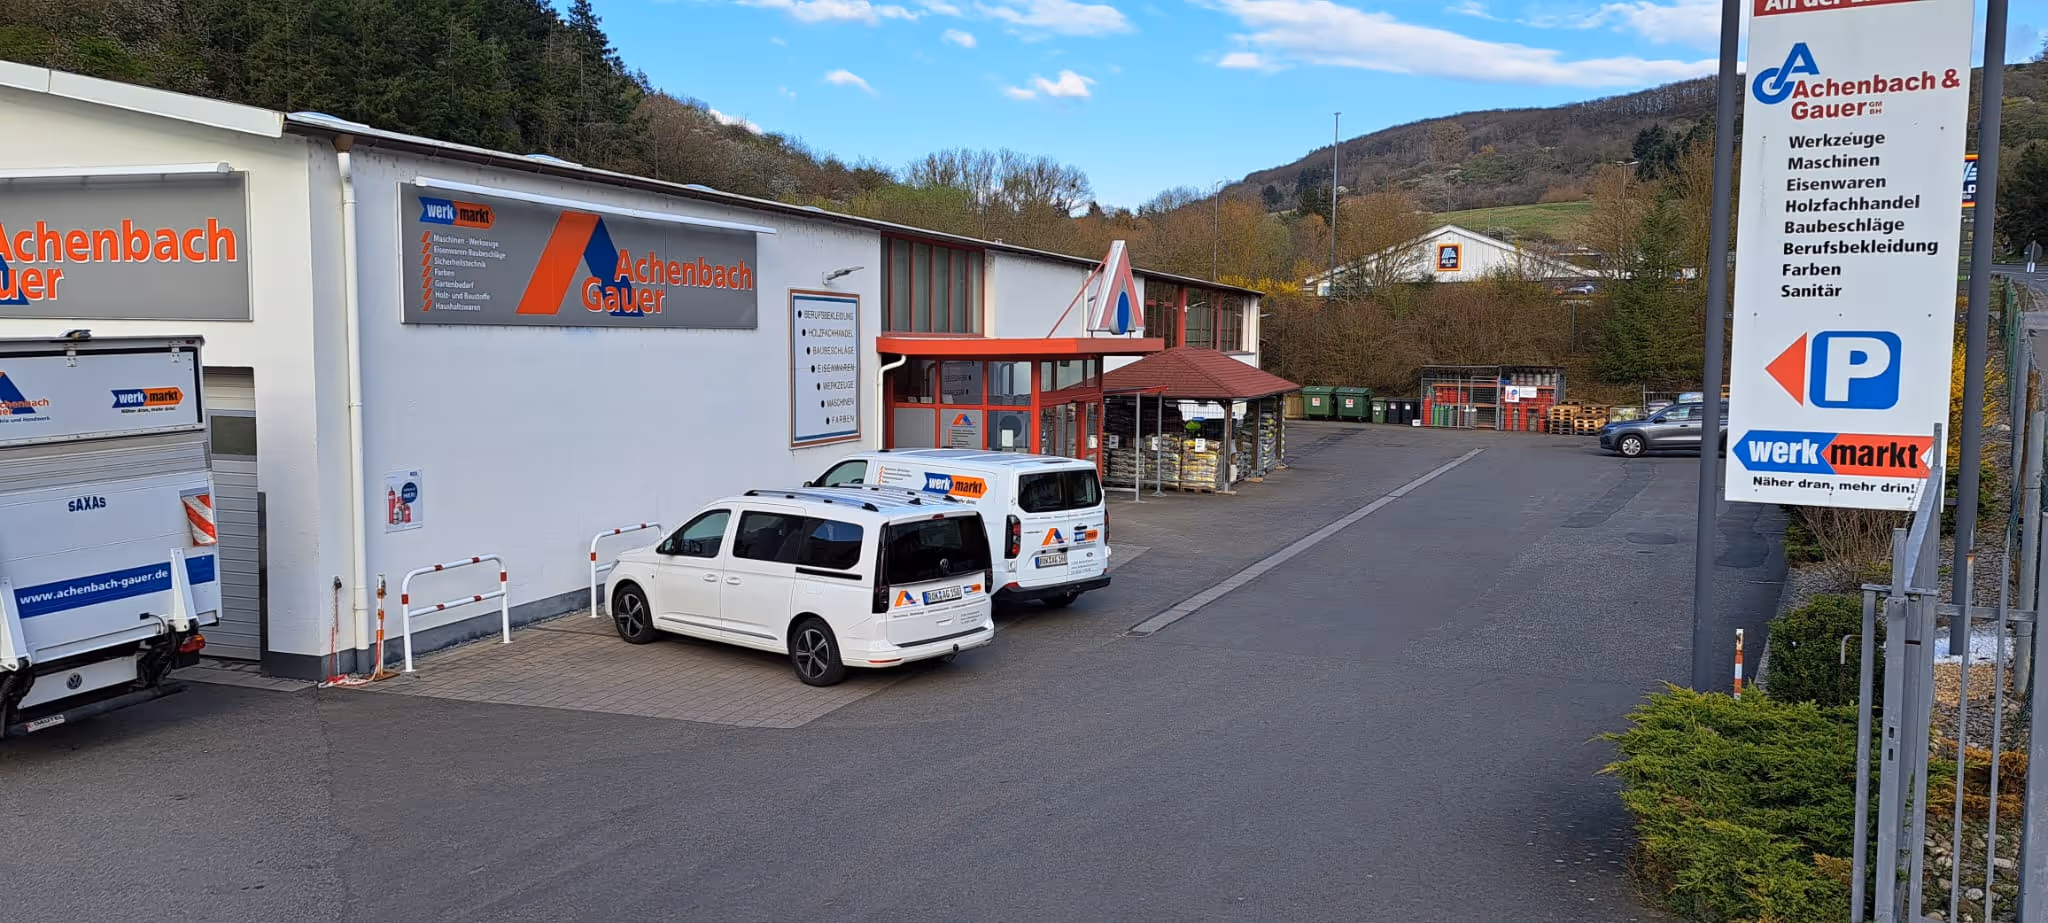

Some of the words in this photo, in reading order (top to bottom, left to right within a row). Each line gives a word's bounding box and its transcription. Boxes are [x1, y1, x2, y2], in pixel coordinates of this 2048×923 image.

[1791, 71, 1936, 99] Achenbach
[1941, 68, 1961, 89] &
[1791, 101, 1868, 121] Gauer
[1789, 132, 1886, 149] Werkzeuge
[1787, 153, 1880, 170] Maschinen
[1786, 176, 1887, 192] Eisenwaren
[1785, 194, 1920, 213] Holzfachhandel
[426, 204, 454, 220] werk
[459, 208, 489, 224] markt
[1784, 218, 1905, 234] Baubeschläge
[433, 234, 465, 244] Maschinen
[469, 238, 499, 248] Werkzeuge
[1783, 239, 1939, 255] Berufsbekleidung
[434, 257, 486, 267] Sicherheitstechnik
[614, 249, 753, 291] Achenbach
[1782, 262, 1841, 276] Farben
[434, 268, 455, 276] Farben
[0, 267, 64, 300] uer
[434, 280, 474, 288] Gartenbedarf
[1781, 284, 1842, 297] Sanitär
[581, 276, 665, 314] Gauer
[435, 302, 481, 311] Haushaltswaren
[804, 310, 854, 321] BERUFSBEKLEIDUNG
[808, 329, 853, 337] HOLZFACHHANDEL
[817, 363, 855, 373] EISENWAREN
[1824, 337, 1890, 402] P
[822, 380, 854, 390] WERKZEUGE
[0, 398, 49, 408] chenbach
[118, 391, 145, 404] werk
[149, 390, 178, 402] markt
[826, 398, 855, 407] MASCHINEN
[831, 414, 855, 424] FARBEN
[1748, 438, 1820, 465] werk
[1830, 442, 1919, 468] markt
[928, 477, 951, 491] werk
[954, 480, 982, 494] markt
[1753, 476, 1795, 487] Näher
[1798, 478, 1834, 491] dran,
[1839, 480, 1877, 492] mehr
[1881, 482, 1916, 494] drin!
[20, 569, 169, 605] www.achenbach-gauer.de
